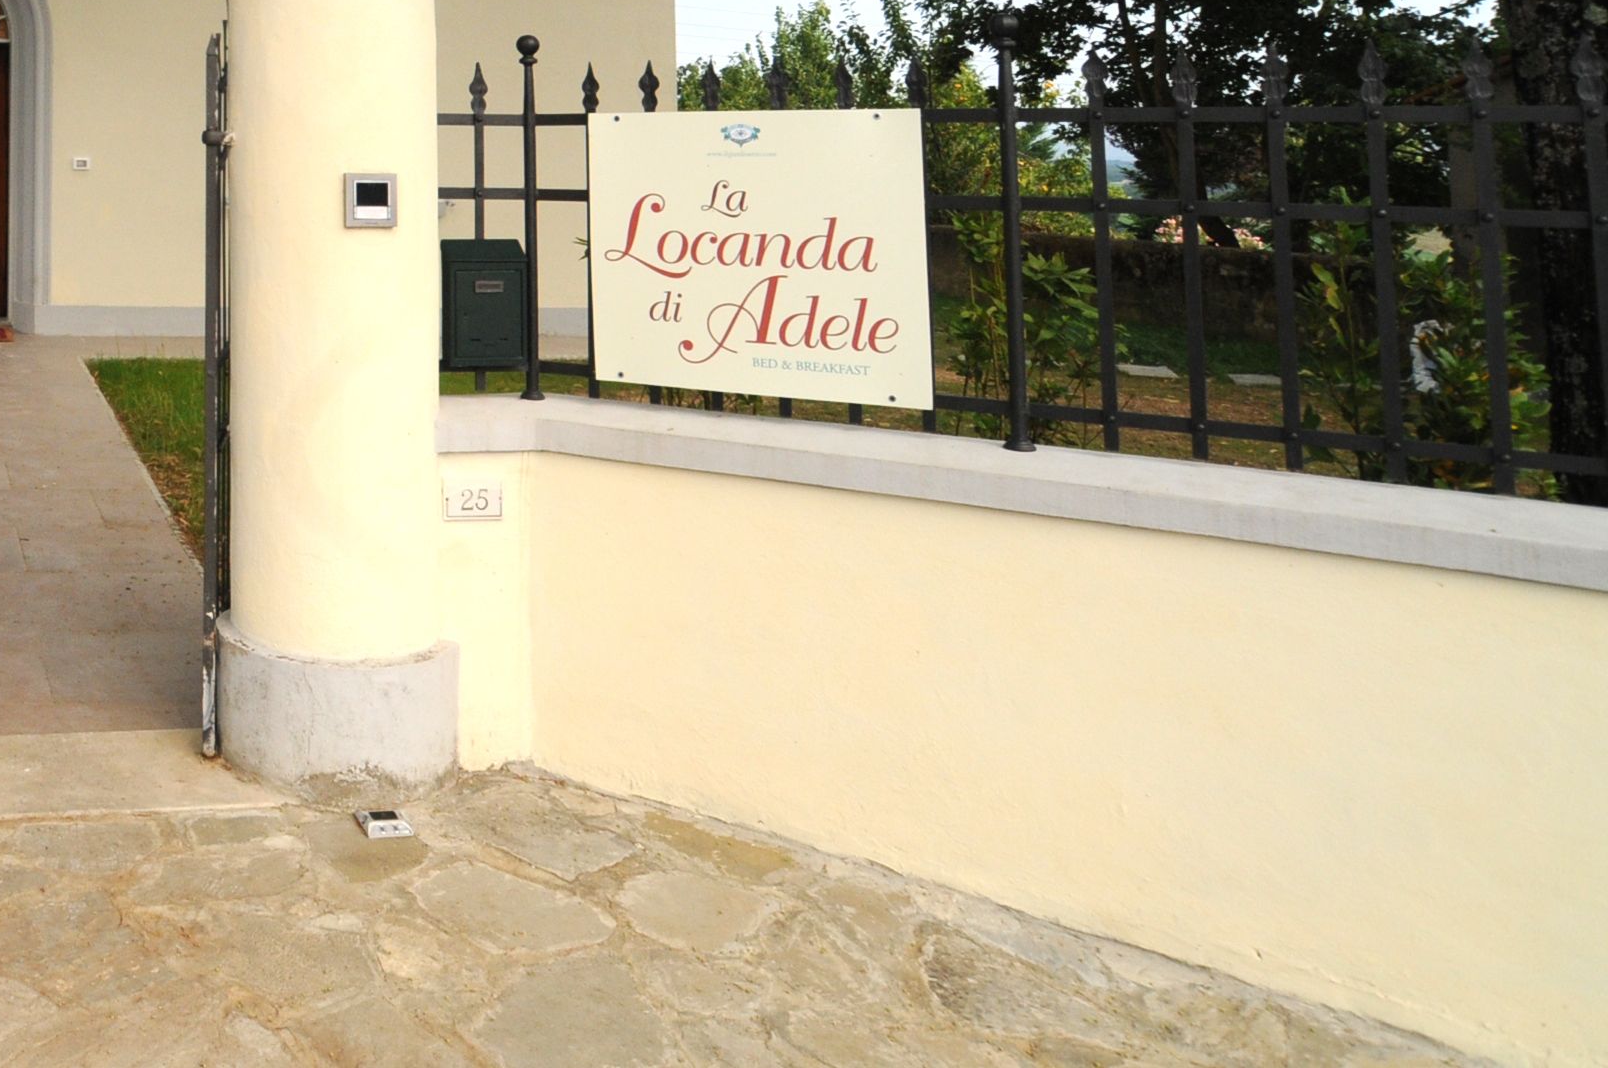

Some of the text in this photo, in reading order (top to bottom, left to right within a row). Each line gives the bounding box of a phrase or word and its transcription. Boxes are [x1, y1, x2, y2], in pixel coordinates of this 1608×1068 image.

[701, 180, 748, 218] La
[603, 192, 878, 279] Locanda
[649, 274, 900, 364] di Adele
[752, 357, 871, 376] BED & BREAKFAST
[461, 489, 488, 511] 25
